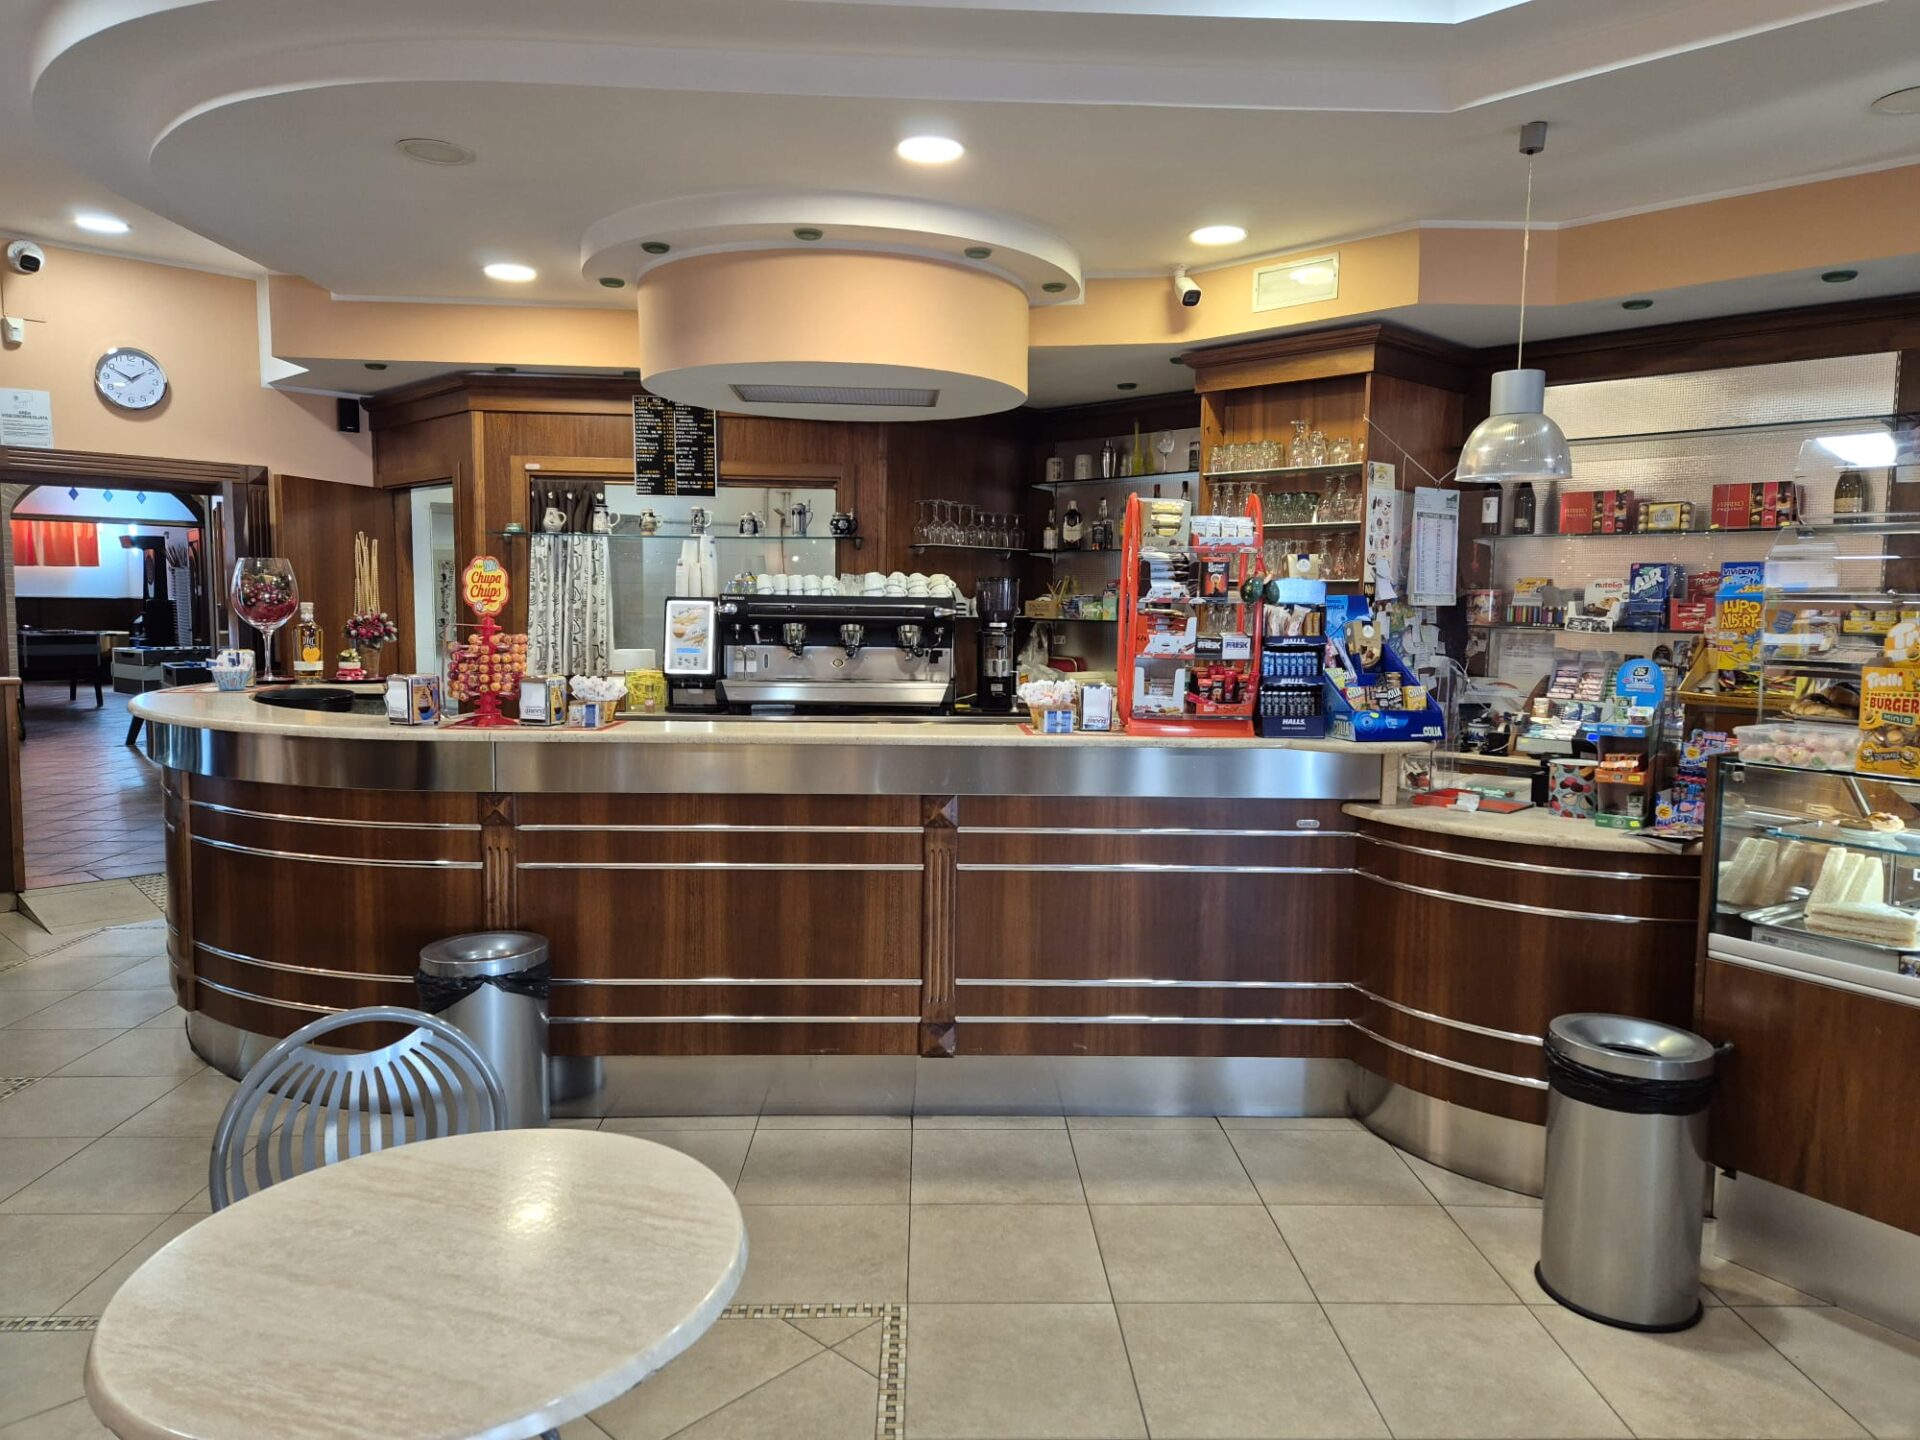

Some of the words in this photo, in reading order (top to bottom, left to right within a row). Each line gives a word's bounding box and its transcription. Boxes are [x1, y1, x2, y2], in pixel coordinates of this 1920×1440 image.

[471, 571, 502, 586] Chupa
[1595, 581, 1622, 589] nutella
[1631, 566, 1664, 594] AIR
[470, 585, 501, 600] Chups
[1724, 600, 1761, 614] LUPO
[1720, 613, 1763, 629] ALBERTO
[1197, 641, 1221, 649] FRISK
[1225, 641, 1248, 649] FRISK
[1869, 697, 1919, 714] BURGER
[1422, 726, 1443, 737] GOLIA
